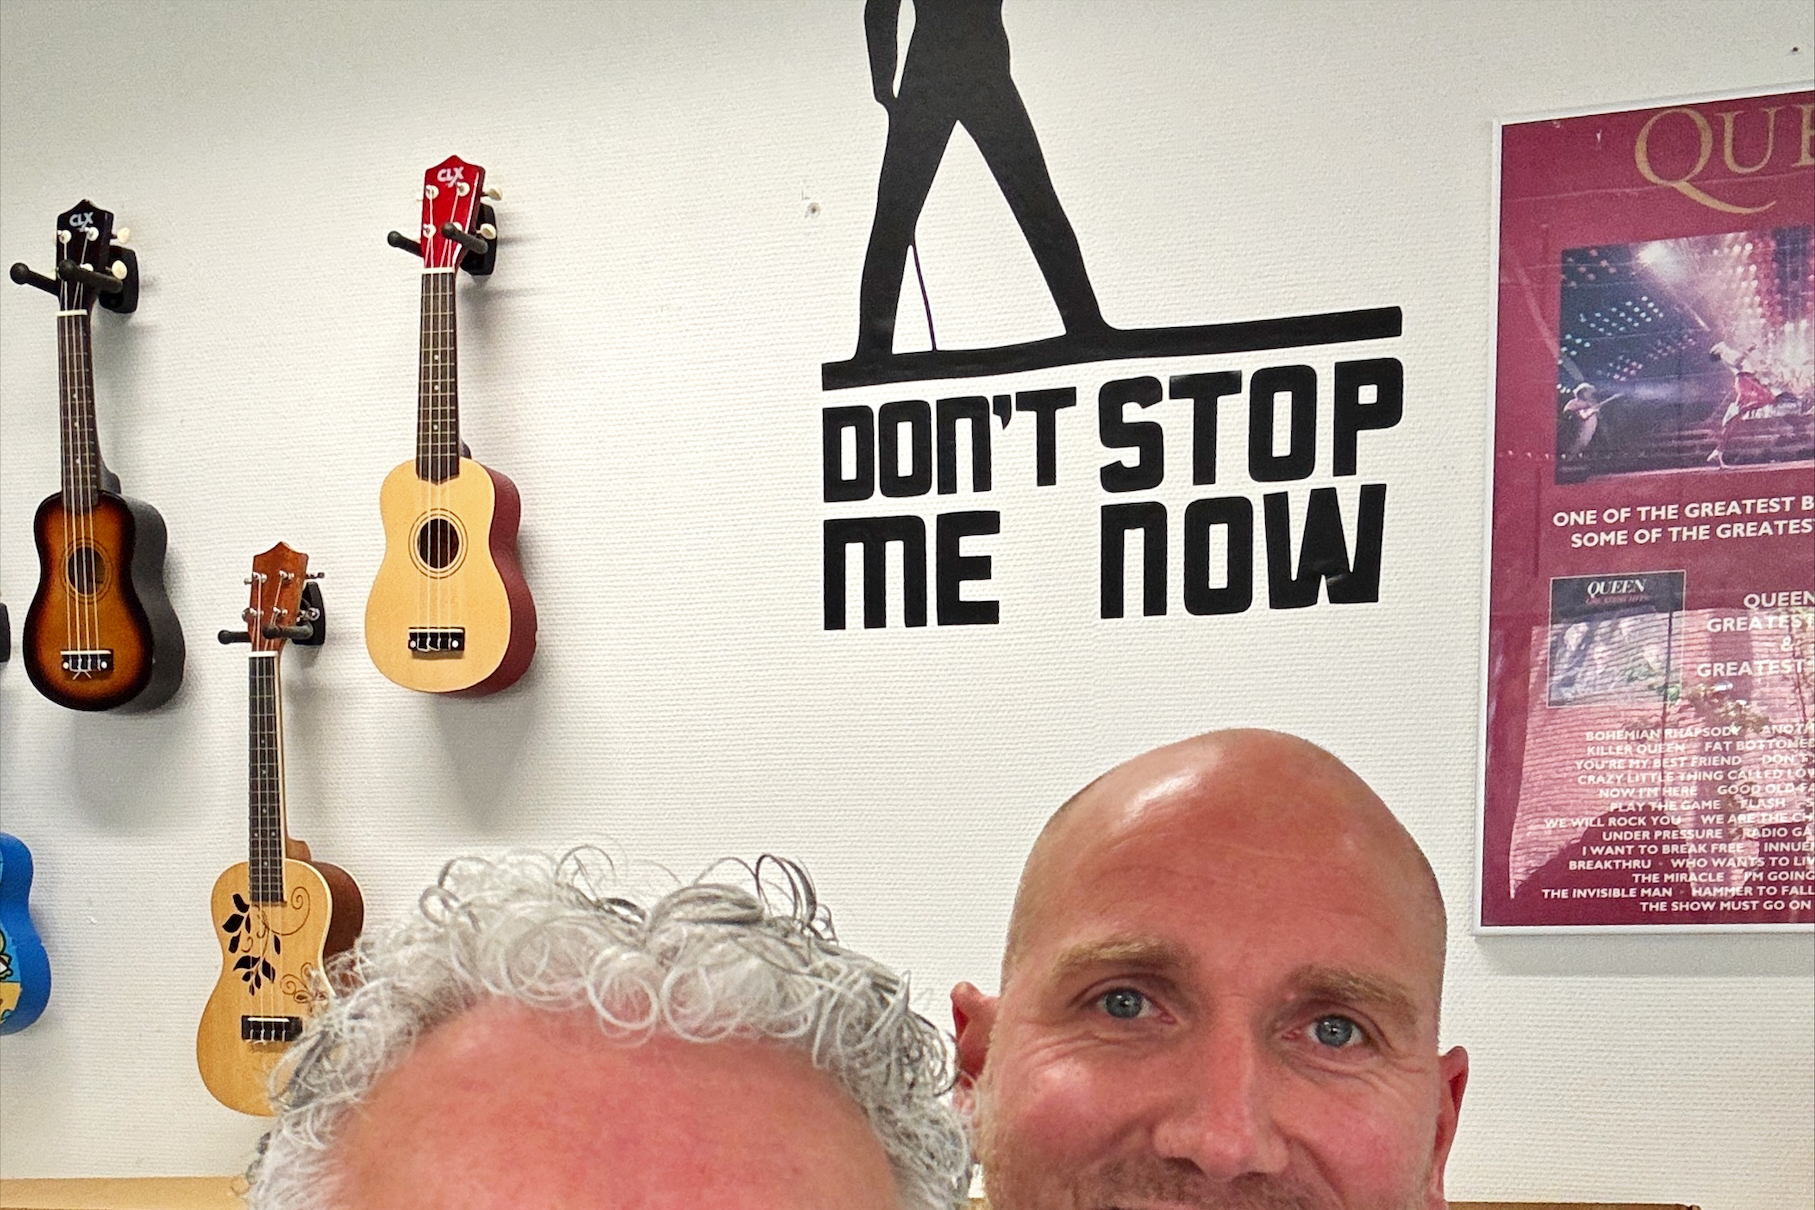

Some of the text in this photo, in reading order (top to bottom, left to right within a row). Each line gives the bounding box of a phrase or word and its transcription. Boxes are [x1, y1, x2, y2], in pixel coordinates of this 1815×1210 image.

[437, 166, 464, 188] CLX
[69, 212, 94, 232] CLX
[822, 357, 1403, 503] DON'T STOP
[1553, 509, 1598, 527] ONE
[1602, 507, 1631, 524] OF
[1636, 504, 1679, 521] THE
[1684, 496, 1796, 518] GREATEST
[1571, 518, 1815, 548] SOME OF THE GREATES
[823, 484, 1387, 630] ME NOW
[1587, 578, 1648, 598] QUEEN
[1743, 590, 1815, 610] QUEEN
[1706, 613, 1815, 633] GREATEST
[1780, 635, 1794, 652] &
[1697, 659, 1805, 677] GREATEST
[1585, 723, 1815, 741] BOHEMIAN RHAPSODY ANOT
[1587, 744, 1632, 756] KILLER
[1636, 743, 1685, 755] QUEEN
[1704, 740, 1733, 752] FAT
[1575, 753, 1808, 770] YOU'RE MY BEST FRIEND DONT
[1578, 773, 1624, 784] CRAZY
[1627, 772, 1674, 783] LITTLE
[1678, 770, 1724, 781] THING
[1727, 769, 1783, 780] CALLED
[1599, 787, 1635, 798] NOW
[1639, 787, 1659, 797] I'M
[1663, 786, 1698, 797] HERE
[1717, 784, 1761, 795] GOOD
[1610, 801, 1645, 812] PLAY
[1648, 801, 1678, 811] THE
[1680, 800, 1721, 811] GAME
[1740, 798, 1785, 809] FLASH
[1544, 817, 1567, 828] WE
[1570, 817, 1605, 828] WILL
[1608, 816, 1646, 826] ROCK
[1650, 815, 1681, 826] YOU
[1700, 814, 1724, 825] WE
[1727, 813, 1755, 824] ARE
[1760, 812, 1788, 823] THE
[1602, 830, 1650, 841] UNDER
[1654, 829, 1723, 840] PRESSURE
[1742, 827, 1788, 838] RADIO
[1582, 845, 1587, 856] I
[1590, 845, 1635, 855] WANT
[1638, 845, 1659, 855] TO
[1661, 843, 1708, 854] BREAK
[1710, 842, 1745, 854] FREE
[1568, 859, 1652, 871] BREAKTHRU
[1670, 858, 1708, 868] WHO
[1711, 856, 1765, 868] WANTS
[1768, 856, 1790, 867] TO
[1632, 870, 1815, 883] THE MIRACLE I'M GOING
[1541, 885, 1815, 899] THE INVISIBLE MAN HAMMER TO FALL
[1639, 900, 1812, 912] THE SHOW MUST GO ON
